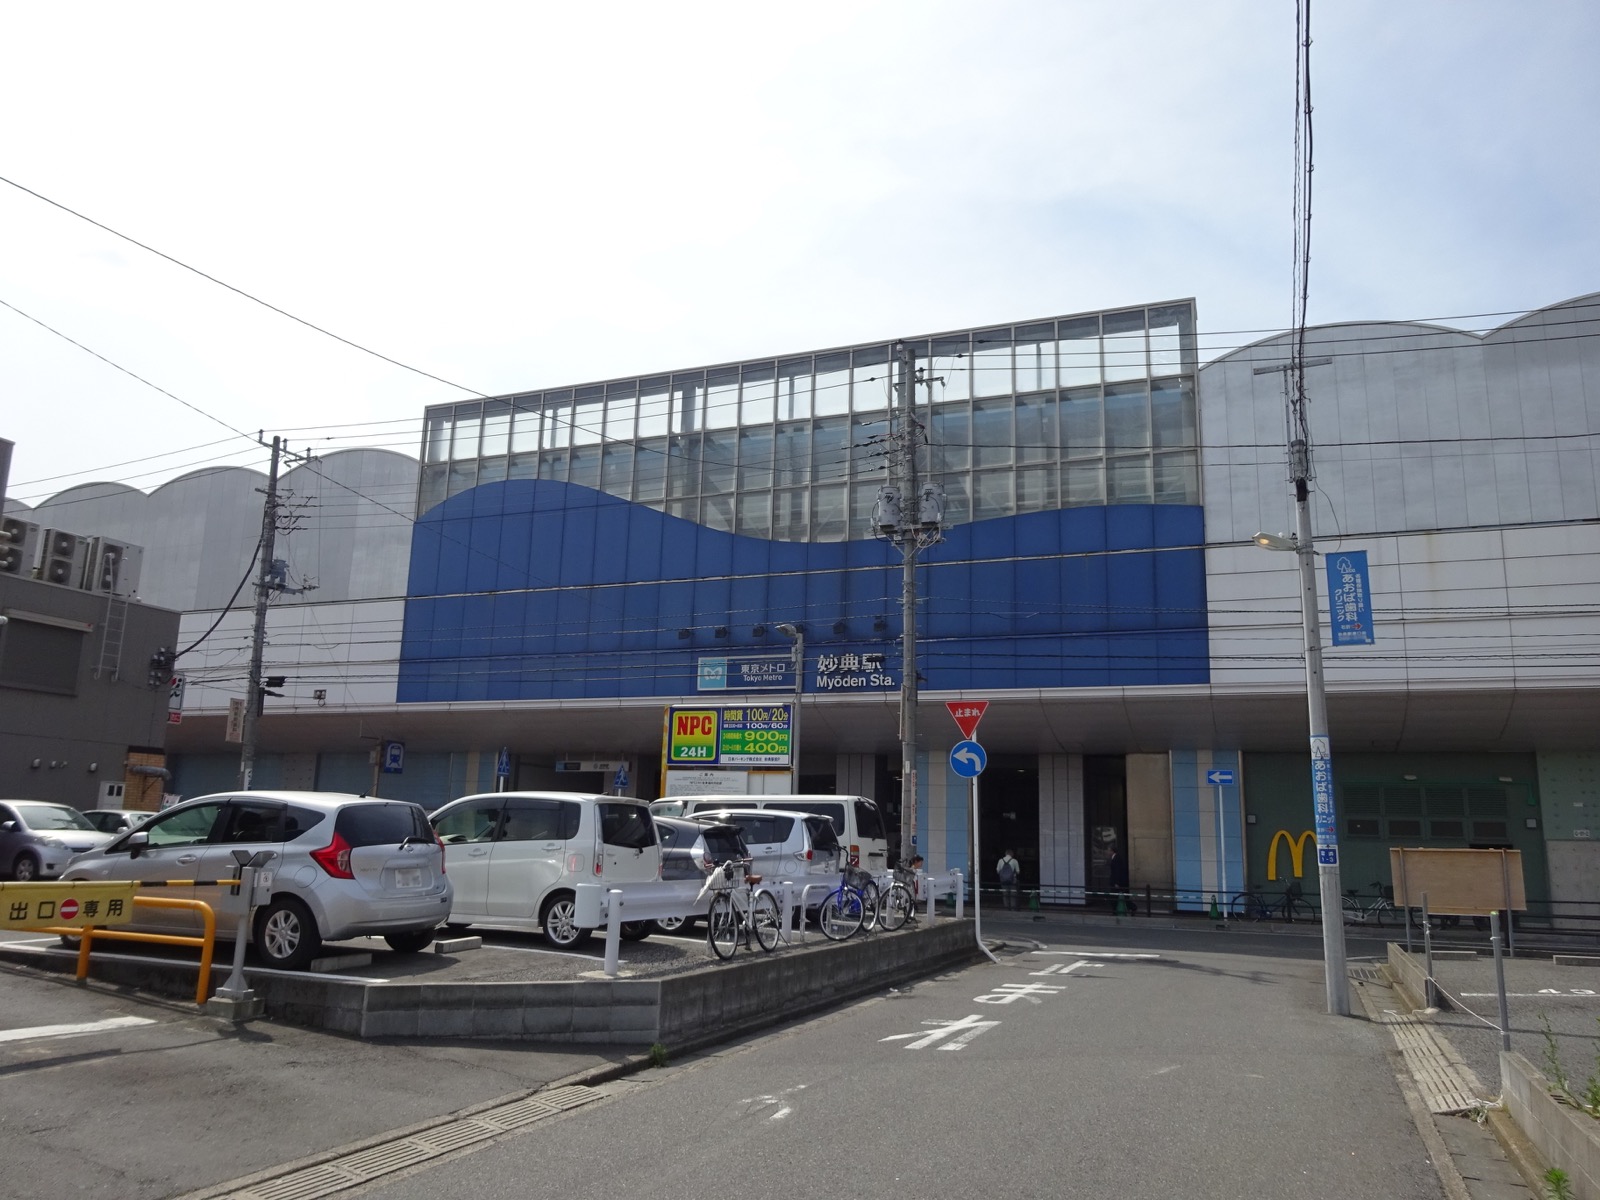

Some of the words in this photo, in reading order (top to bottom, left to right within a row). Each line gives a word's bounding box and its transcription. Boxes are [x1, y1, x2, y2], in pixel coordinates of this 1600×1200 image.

[1334, 588, 1345, 622] クリニック
[1341, 573, 1358, 622] あおば歯科
[740, 663, 786, 674] 東京メトロ
[817, 653, 883, 674] 妙典駅
[743, 674, 762, 683] Tokyo
[816, 674, 866, 690] Myōden
[870, 673, 895, 686] Sta.
[746, 708, 789, 721] 100円/20分
[955, 708, 981, 717] 止まれ
[677, 715, 712, 736] NPC
[744, 730, 788, 741] 900円
[680, 746, 707, 758] 24H
[744, 742, 788, 753] 400円
[1314, 760, 1329, 814] あおば歯科
[9, 901, 55, 920] 出口
[83, 899, 124, 918] 専用
[877, 960, 1105, 1050] 止まれ
